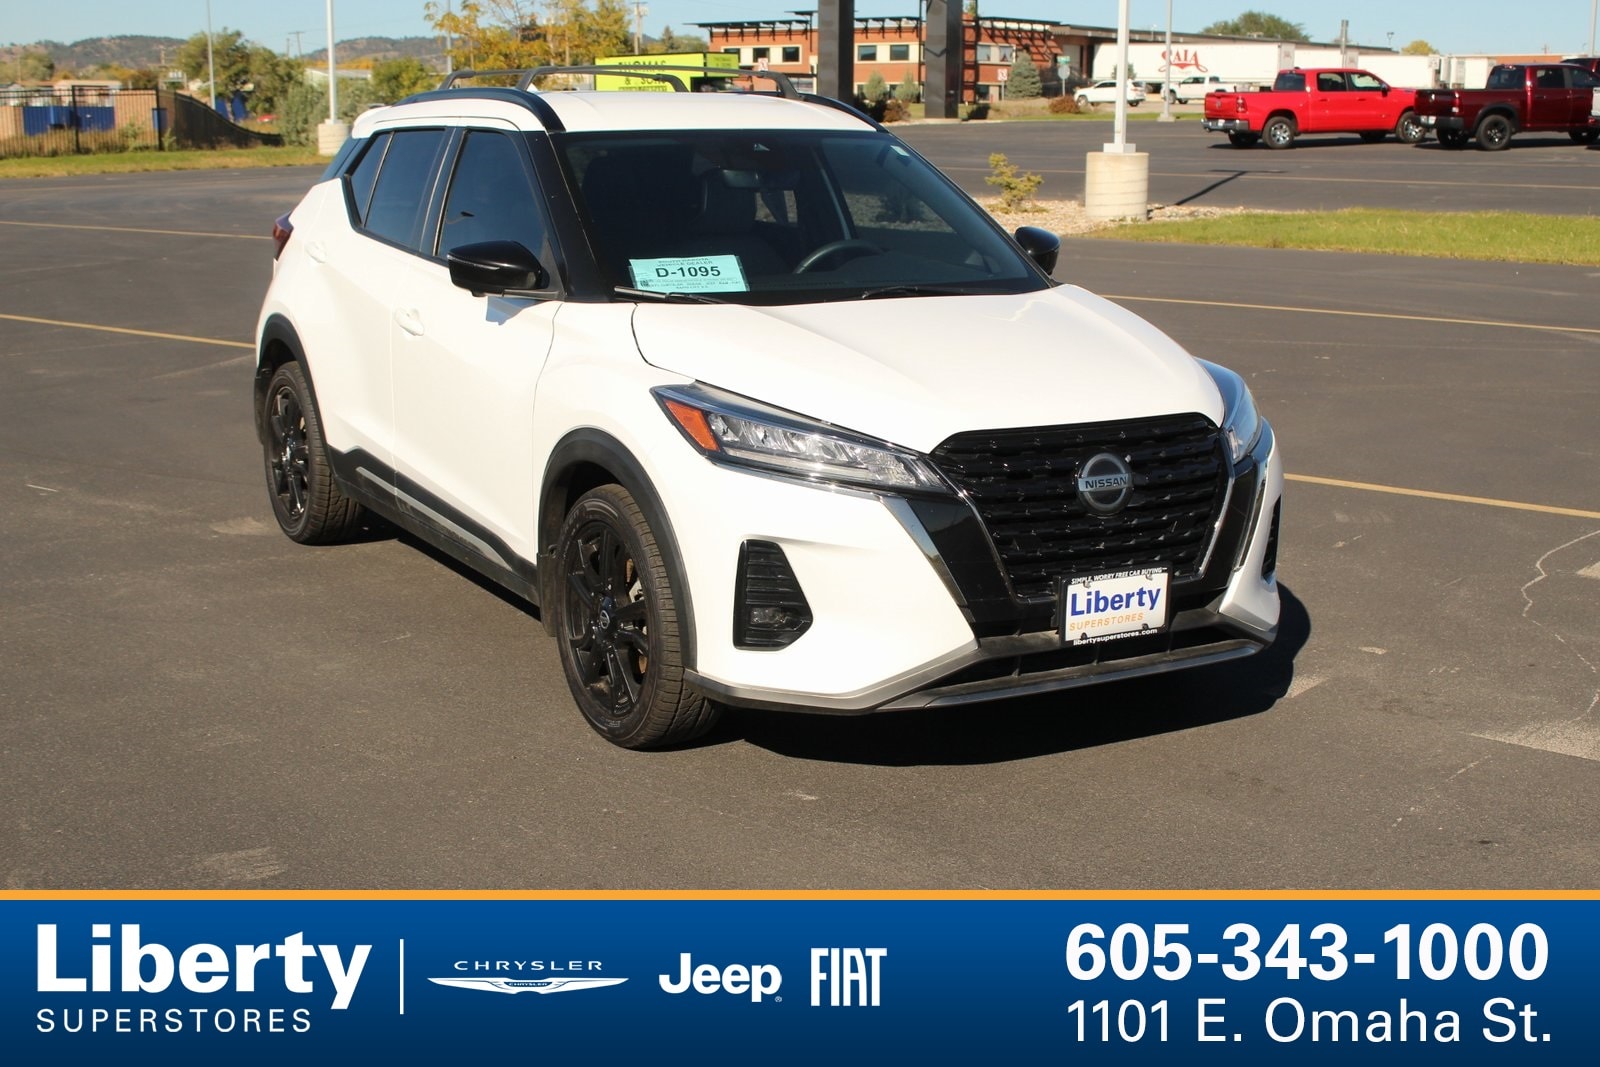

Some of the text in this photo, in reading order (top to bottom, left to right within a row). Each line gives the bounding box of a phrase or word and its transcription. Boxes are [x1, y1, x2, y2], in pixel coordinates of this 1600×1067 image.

[1158, 49, 1208, 73] SAIA
[655, 265, 721, 278] D-1095
[1085, 476, 1127, 489] NISSAN
[1094, 573, 1115, 581] WORRY
[1129, 569, 1141, 577] CAR
[1070, 586, 1161, 617] Liberty
[1069, 612, 1145, 631] SUPERSTORES
[1073, 628, 1158, 646] libertysuperstores.com
